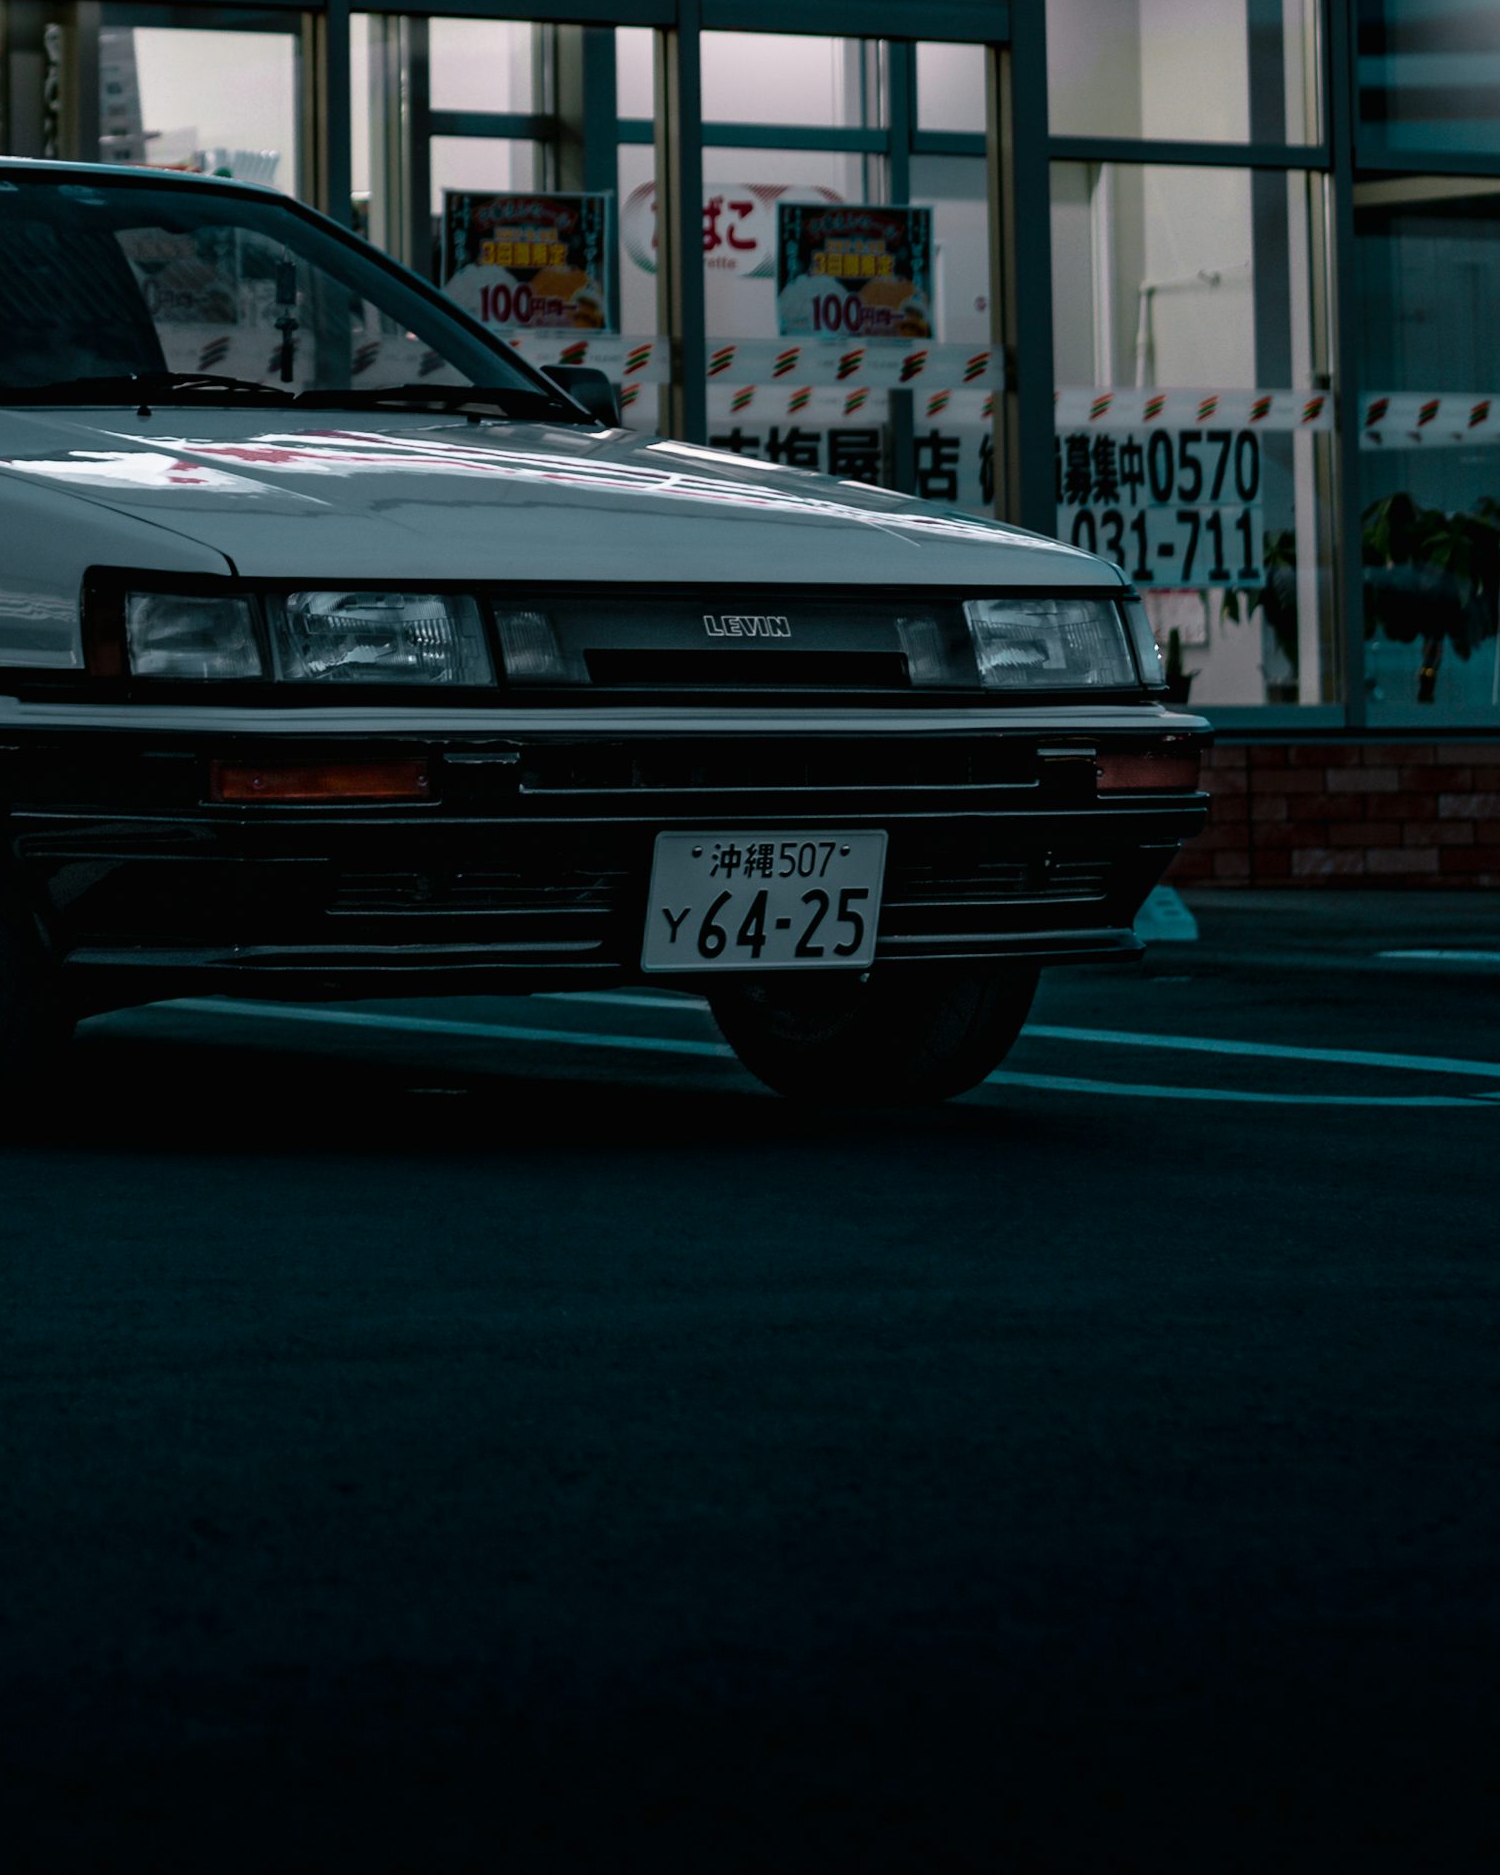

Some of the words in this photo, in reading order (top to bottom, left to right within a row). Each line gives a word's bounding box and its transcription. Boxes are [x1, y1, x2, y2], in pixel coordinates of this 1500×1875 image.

[1147, 429, 1261, 503] 0570
[1071, 509, 1261, 581] 031-711
[703, 614, 791, 637] LEVIN
[661, 908, 691, 943] Y
[697, 888, 870, 959] 64-25
